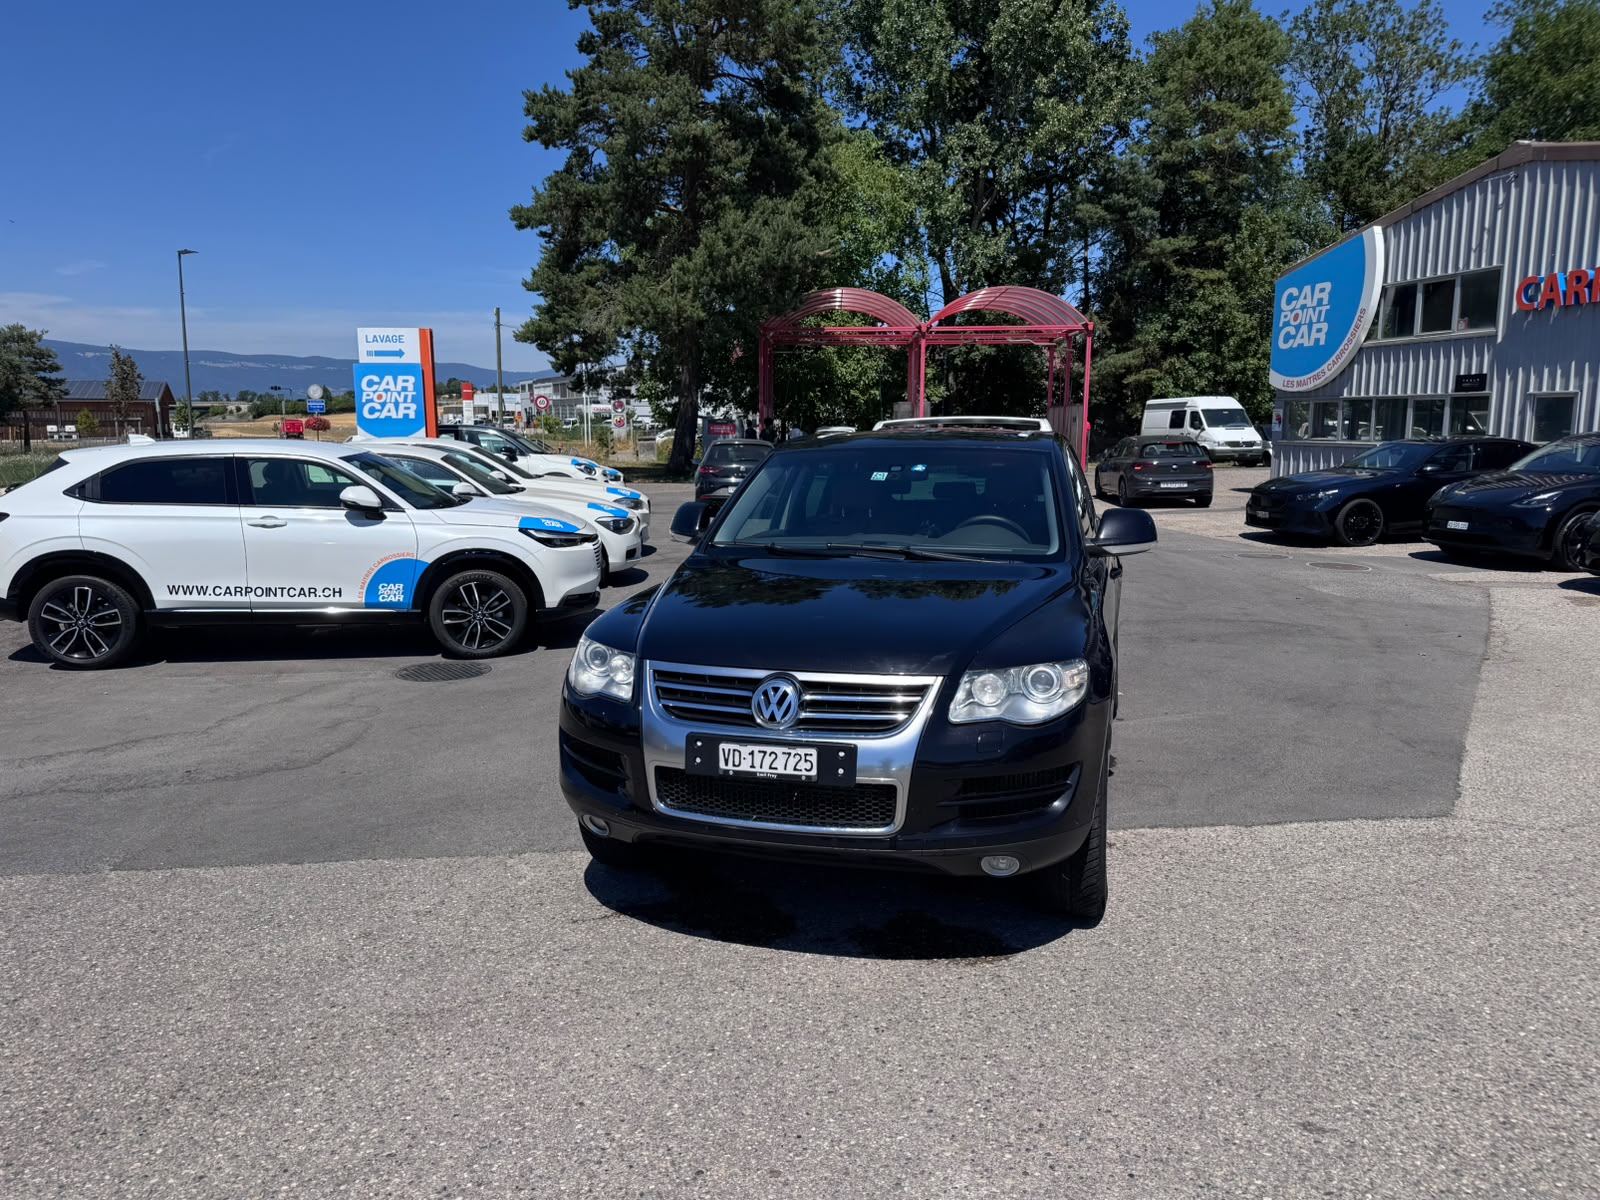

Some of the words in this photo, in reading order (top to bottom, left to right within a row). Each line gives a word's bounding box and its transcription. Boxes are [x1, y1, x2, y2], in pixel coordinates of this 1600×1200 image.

[1280, 282, 1332, 311] CAR
[1516, 266, 1600, 311] CAR
[1279, 305, 1331, 327] POINT
[365, 334, 405, 344] LAVAGE
[1278, 323, 1329, 350] CAR
[1282, 379, 1295, 389] LES
[1295, 370, 1327, 389] MAITRES
[1326, 307, 1367, 373] CARROSSIERS
[361, 374, 416, 392] CAR
[362, 391, 417, 403] POINT
[362, 403, 417, 419] CAR
[373, 552, 415, 568] CARROSSIERS
[167, 584, 342, 598] WWW.CARPOINTCAR.CH
[378, 583, 404, 591] CAR
